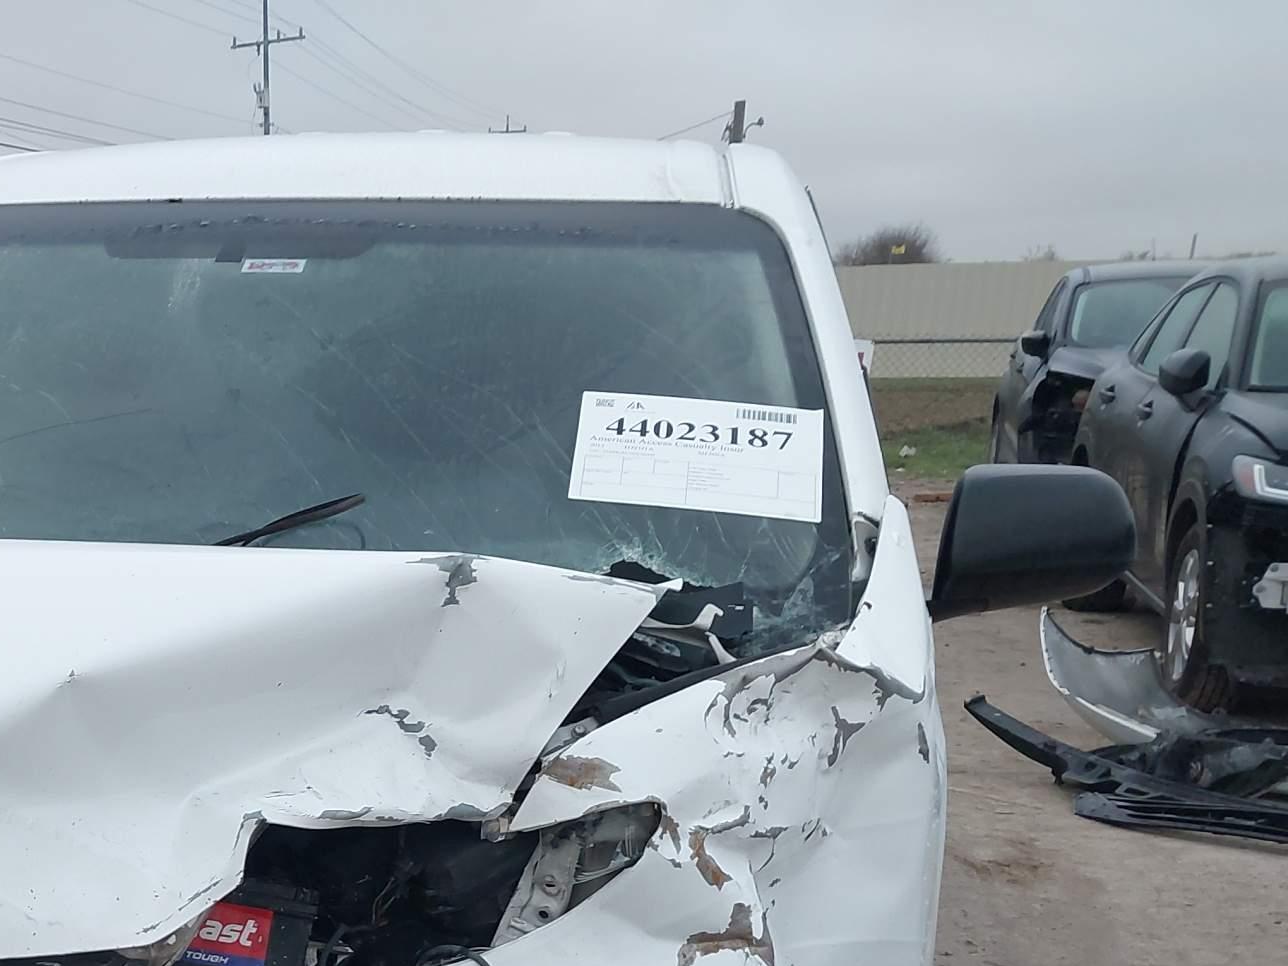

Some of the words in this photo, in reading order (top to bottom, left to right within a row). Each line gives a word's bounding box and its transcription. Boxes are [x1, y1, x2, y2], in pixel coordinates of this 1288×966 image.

[589, 434, 636, 445] American
[605, 416, 794, 450] 44023187
[197, 919, 258, 947] ast
[185, 950, 230, 964] TOUGH
